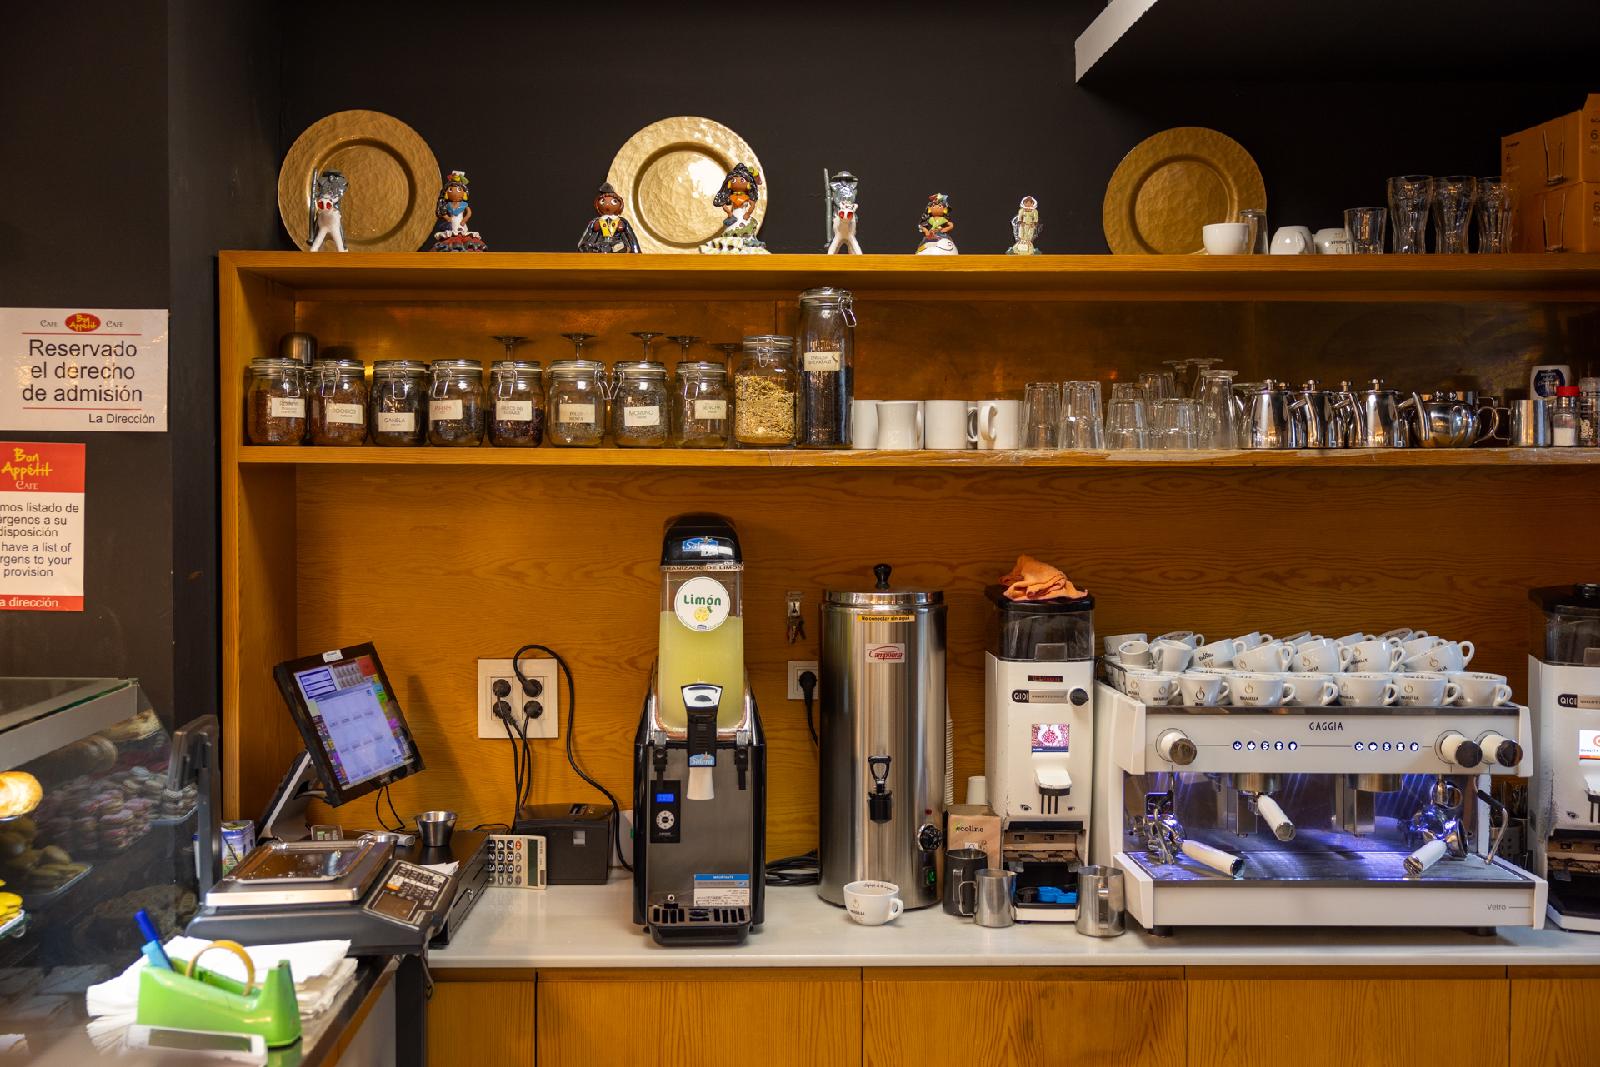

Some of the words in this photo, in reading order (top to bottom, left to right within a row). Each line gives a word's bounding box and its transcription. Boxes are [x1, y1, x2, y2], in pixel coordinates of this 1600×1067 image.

[29, 339, 137, 357] Reservado
[31, 362, 47, 378] el
[54, 362, 135, 380] derecho
[22, 385, 47, 401] de
[54, 385, 143, 402] admisión
[88, 413, 103, 423] La
[107, 414, 155, 424] Dirección
[13, 448, 39, 462] Bon
[1, 463, 53, 481] Appétit
[27, 502, 62, 513] listado
[66, 503, 79, 513] de
[1, 542, 29, 552] have
[42, 541, 57, 552] list
[60, 543, 72, 552] of
[34, 557, 44, 565] to
[48, 559, 72, 568] your
[3, 567, 54, 578] provision
[9, 597, 59, 608] dirección
[684, 594, 721, 606] Limón
